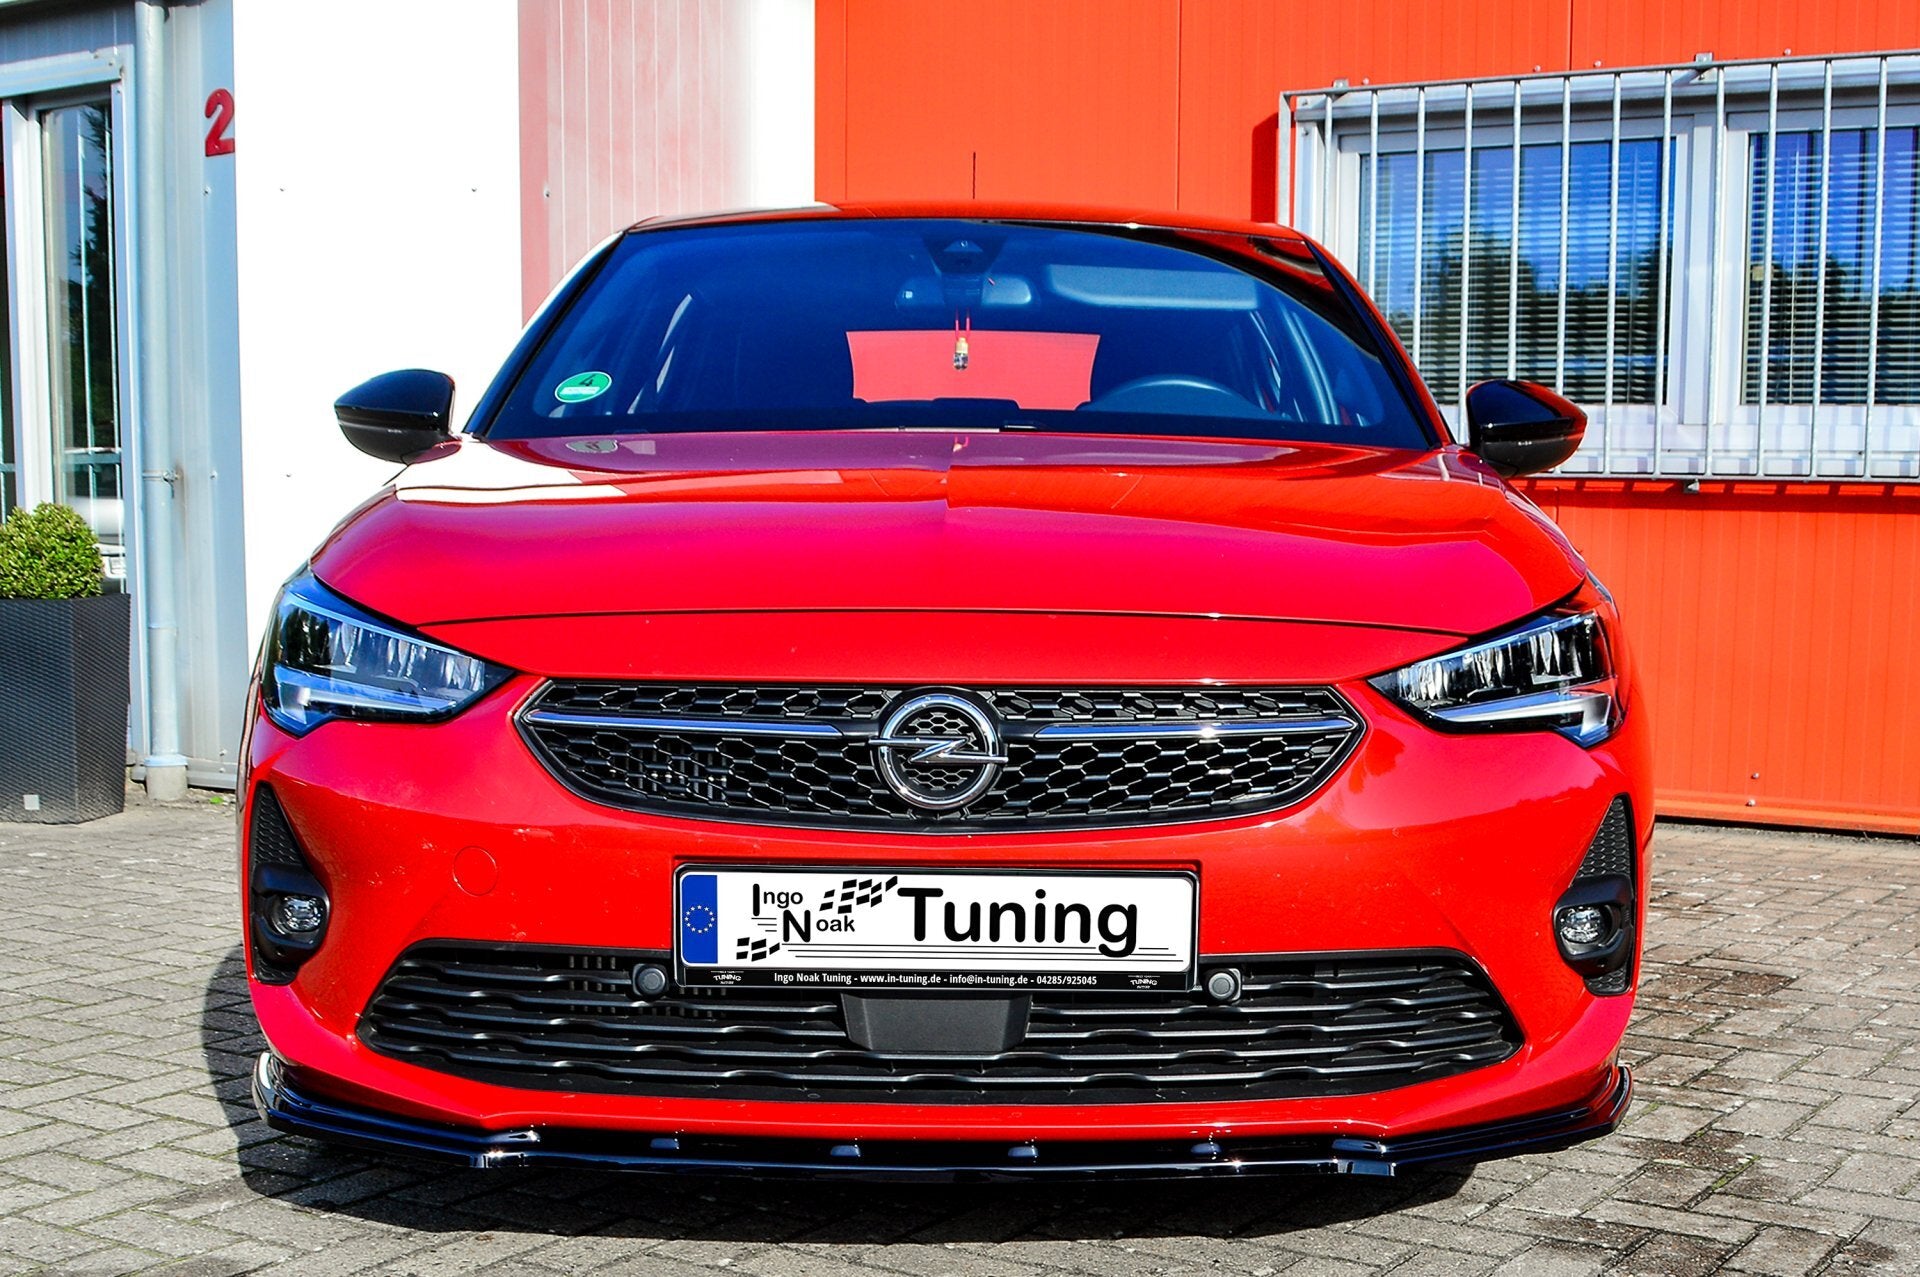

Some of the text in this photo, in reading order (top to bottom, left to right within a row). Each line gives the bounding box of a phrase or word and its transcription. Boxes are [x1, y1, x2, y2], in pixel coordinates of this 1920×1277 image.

[205, 88, 235, 157] 2
[579, 374, 597, 387] 4
[752, 883, 804, 917] Ingo
[783, 909, 855, 943] Noak
[897, 887, 1138, 958] Tuning
[774, 973, 794, 984] Ingo
[796, 973, 820, 983] Noak
[822, 973, 852, 985] Tuning
[860, 973, 941, 986] www.in-tuning.de
[949, 974, 1028, 987] info@in-tuning.de
[1036, 975, 1098, 986] 04285/925045
